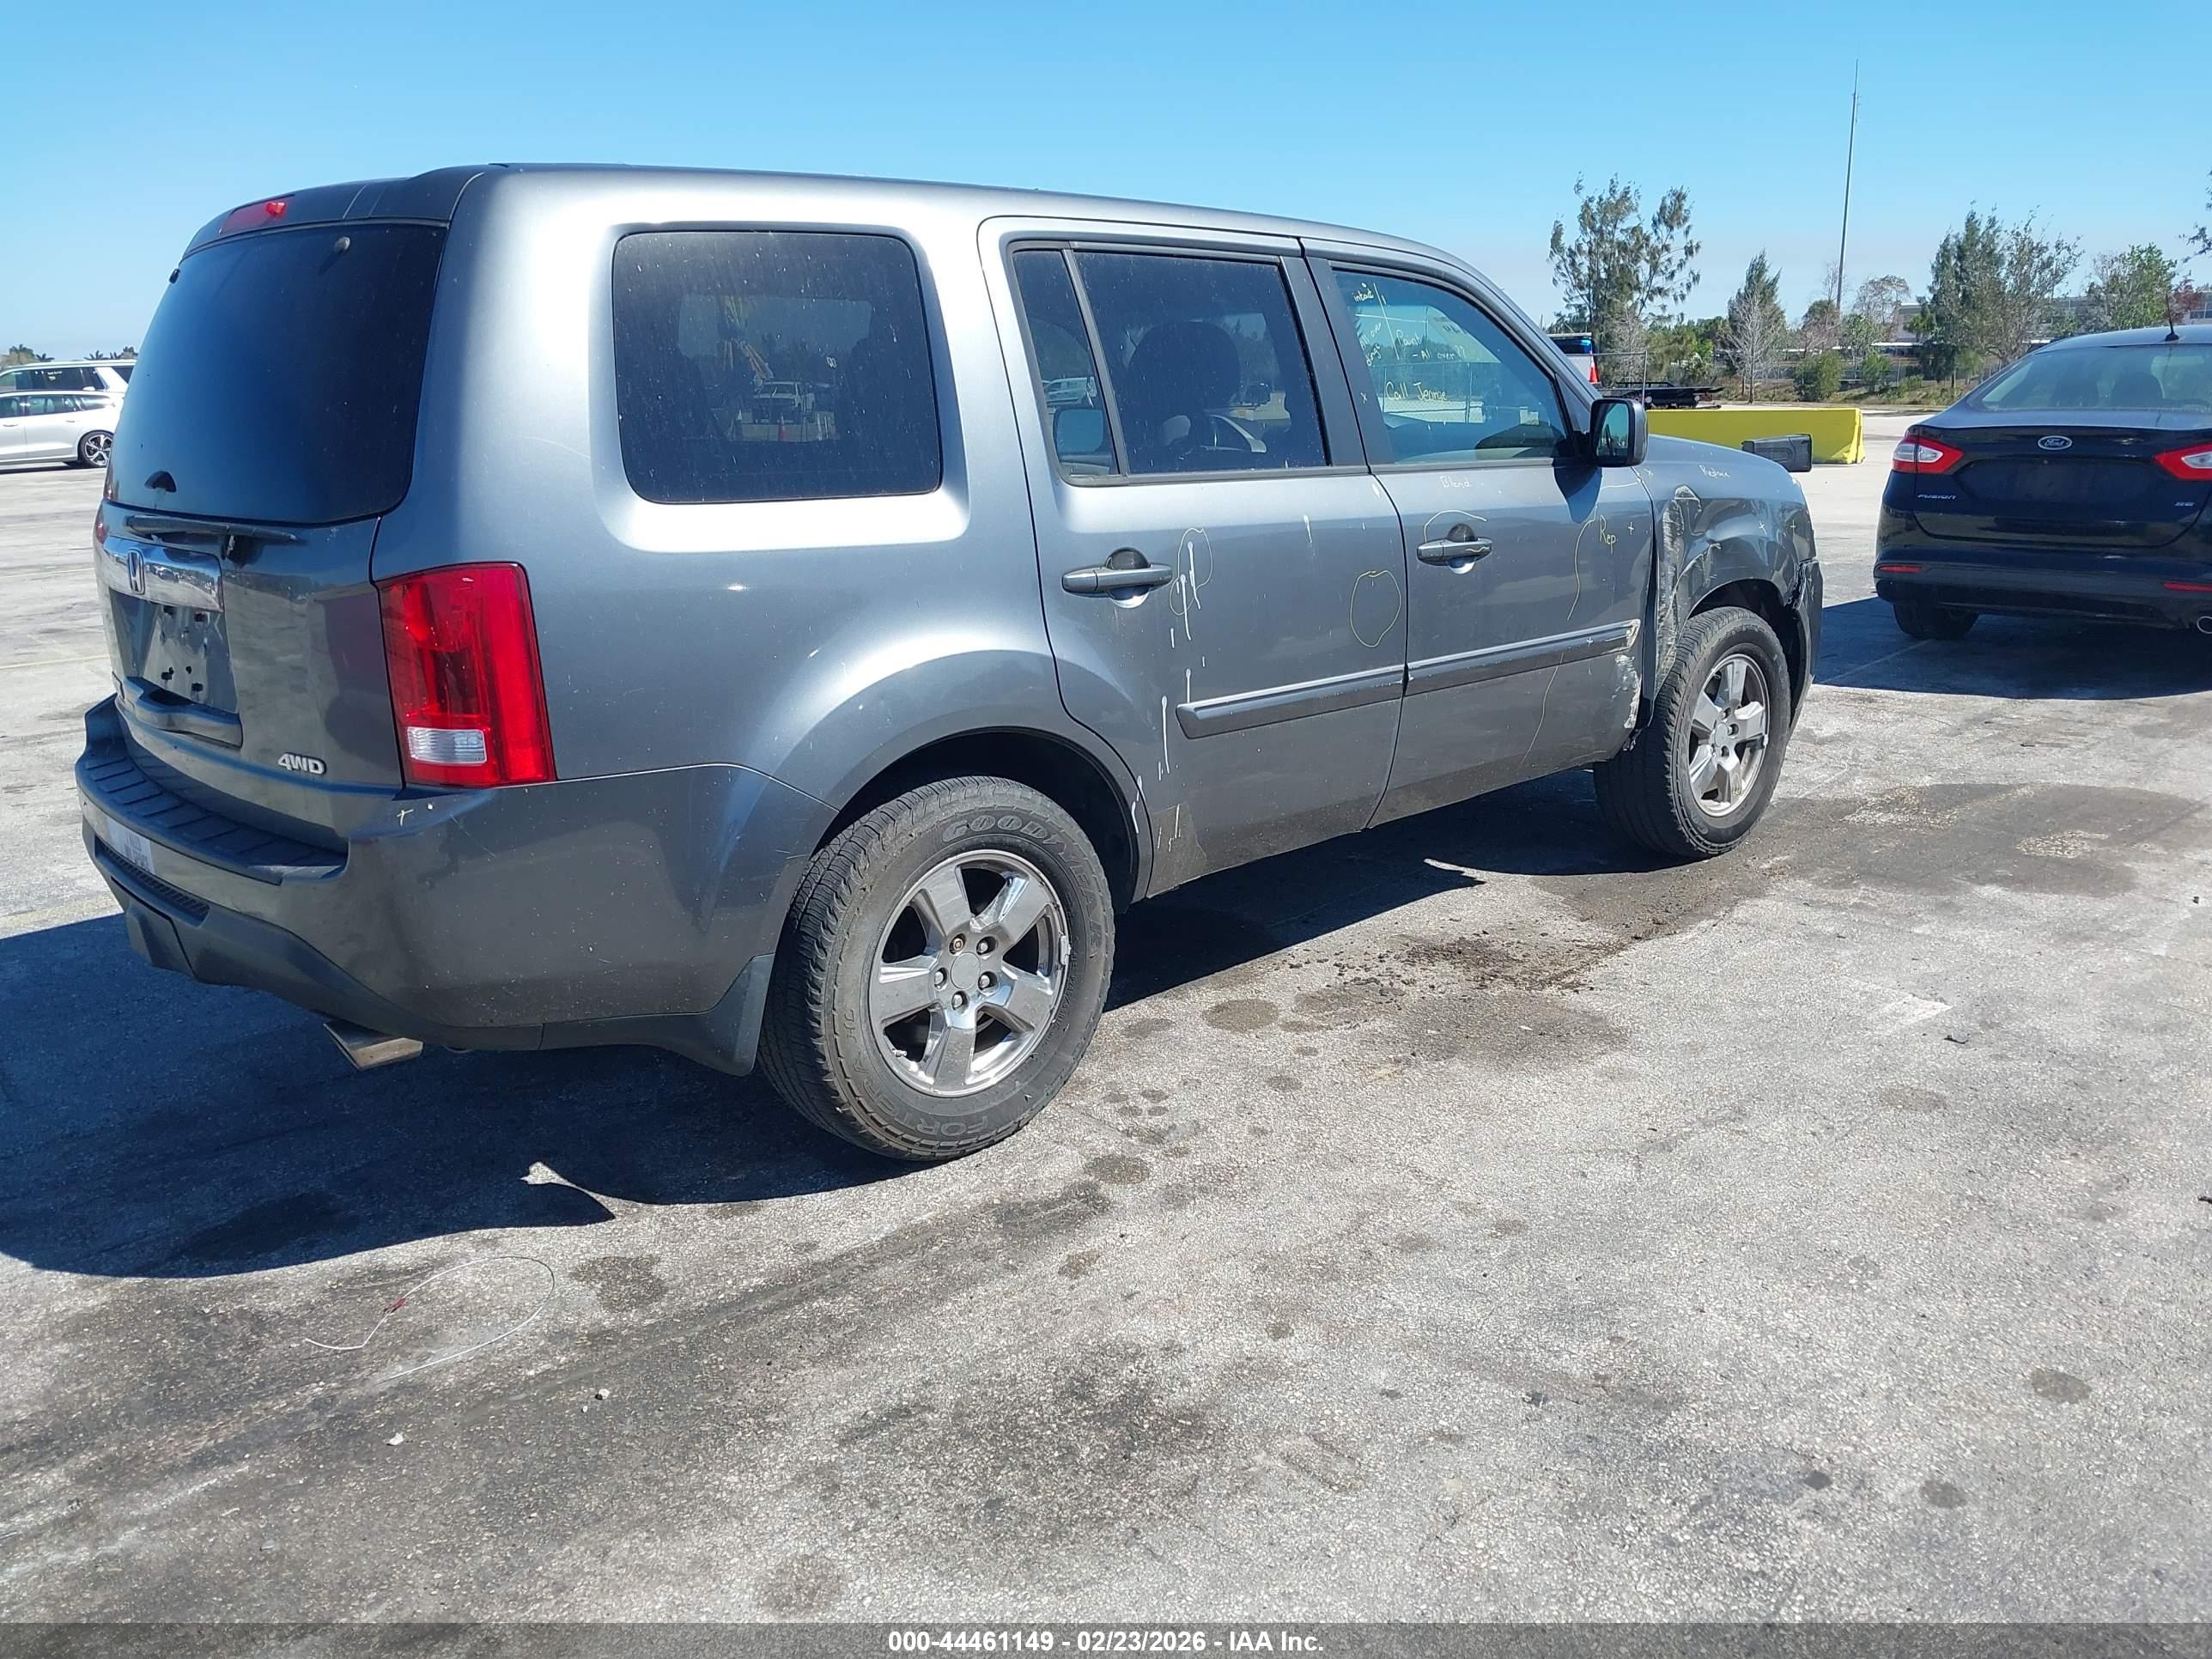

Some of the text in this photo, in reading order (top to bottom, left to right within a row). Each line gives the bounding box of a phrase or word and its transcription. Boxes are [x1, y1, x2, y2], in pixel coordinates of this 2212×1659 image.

[1396, 329, 1423, 346] Paint
[1385, 381, 1408, 400] Call
[2044, 438, 2065, 447] Ford
[277, 752, 325, 775] 4WD
[941, 815, 1103, 948] GOODYEAR
